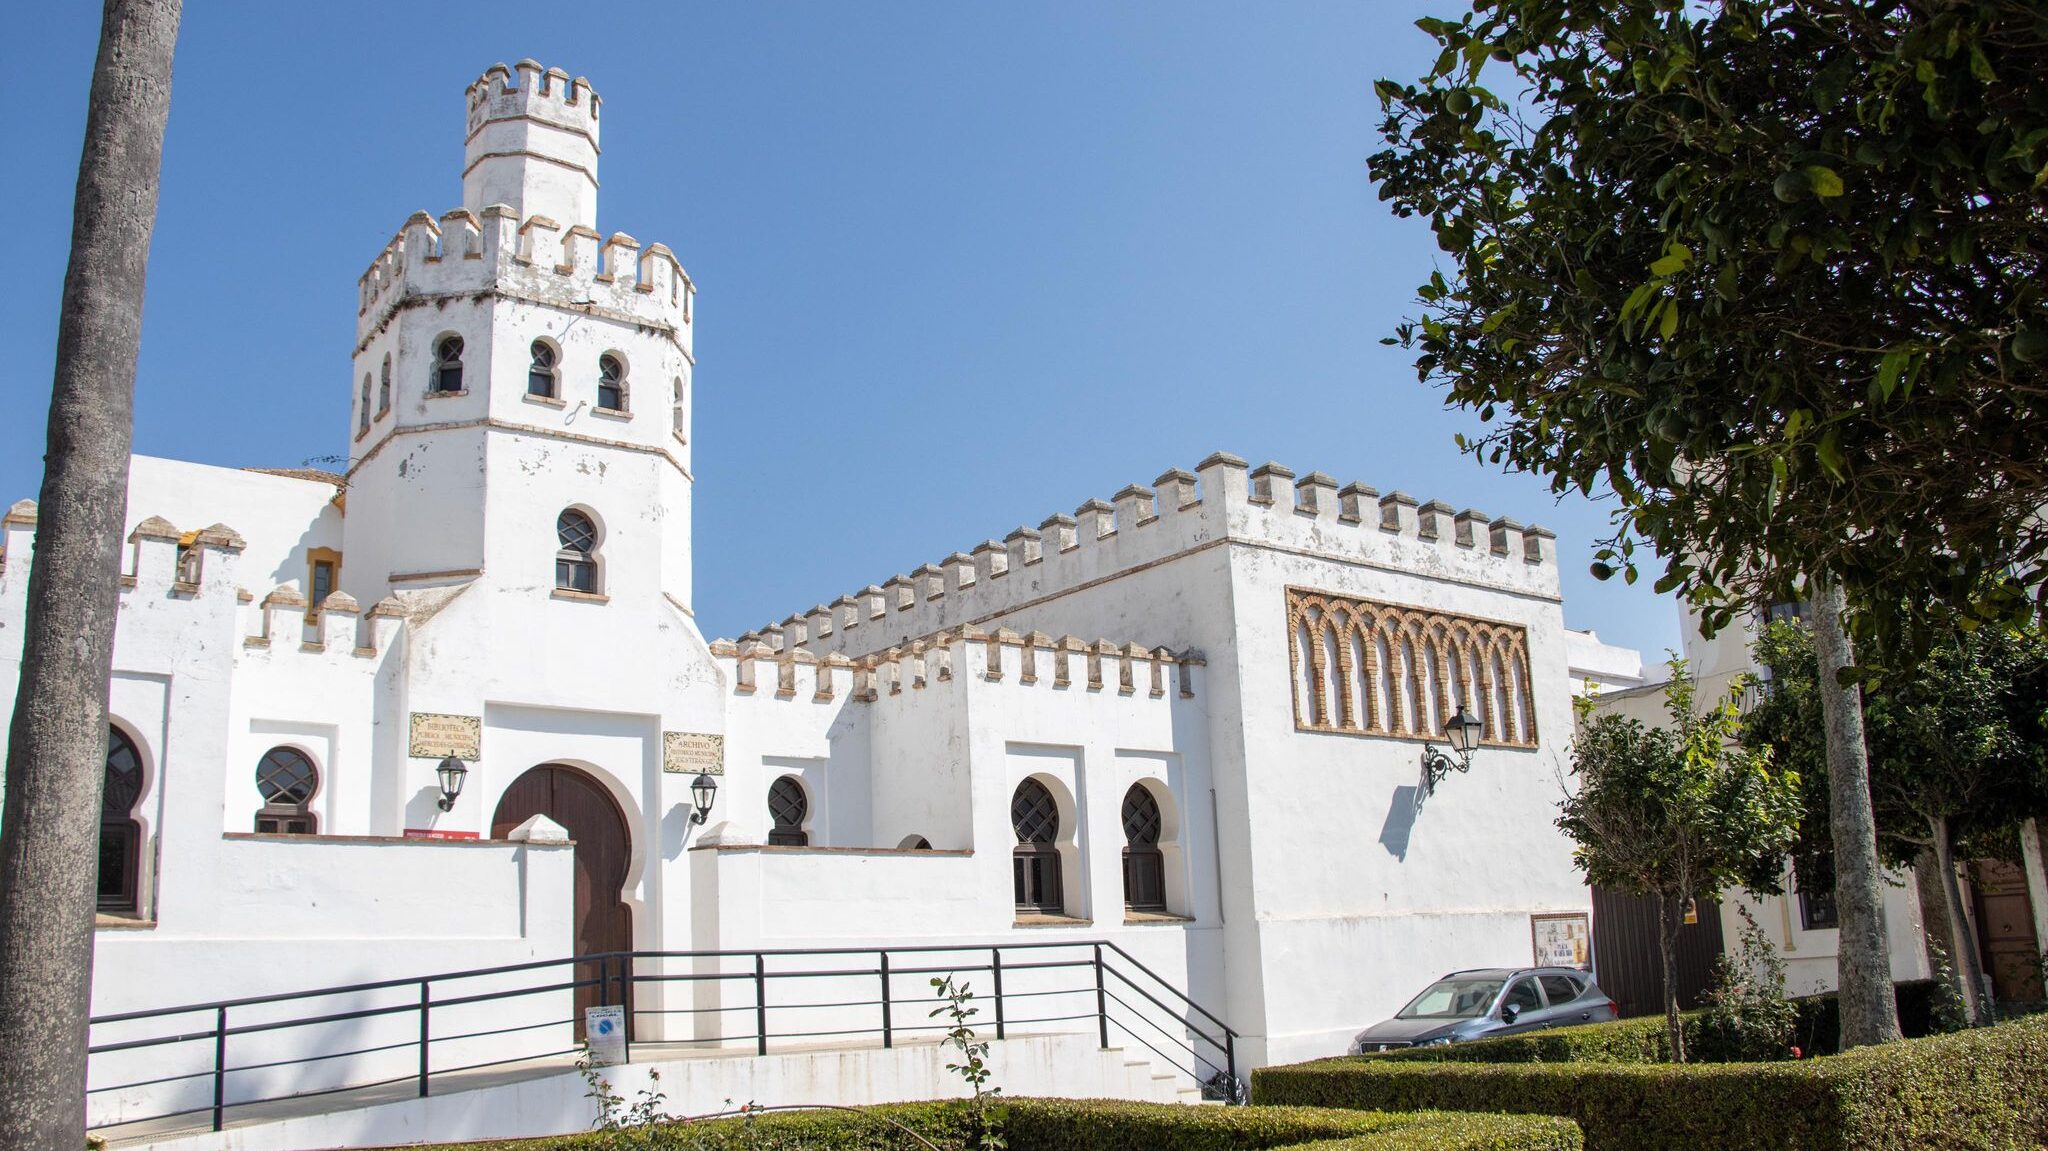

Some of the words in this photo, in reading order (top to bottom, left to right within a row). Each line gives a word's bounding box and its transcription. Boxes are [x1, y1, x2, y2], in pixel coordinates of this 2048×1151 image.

[428, 723, 465, 732] BIBLIOTECA
[445, 733, 474, 741] MUNICIPAL
[679, 740, 710, 749] ARCHIVO
[694, 750, 718, 758] MUNICIPAL
